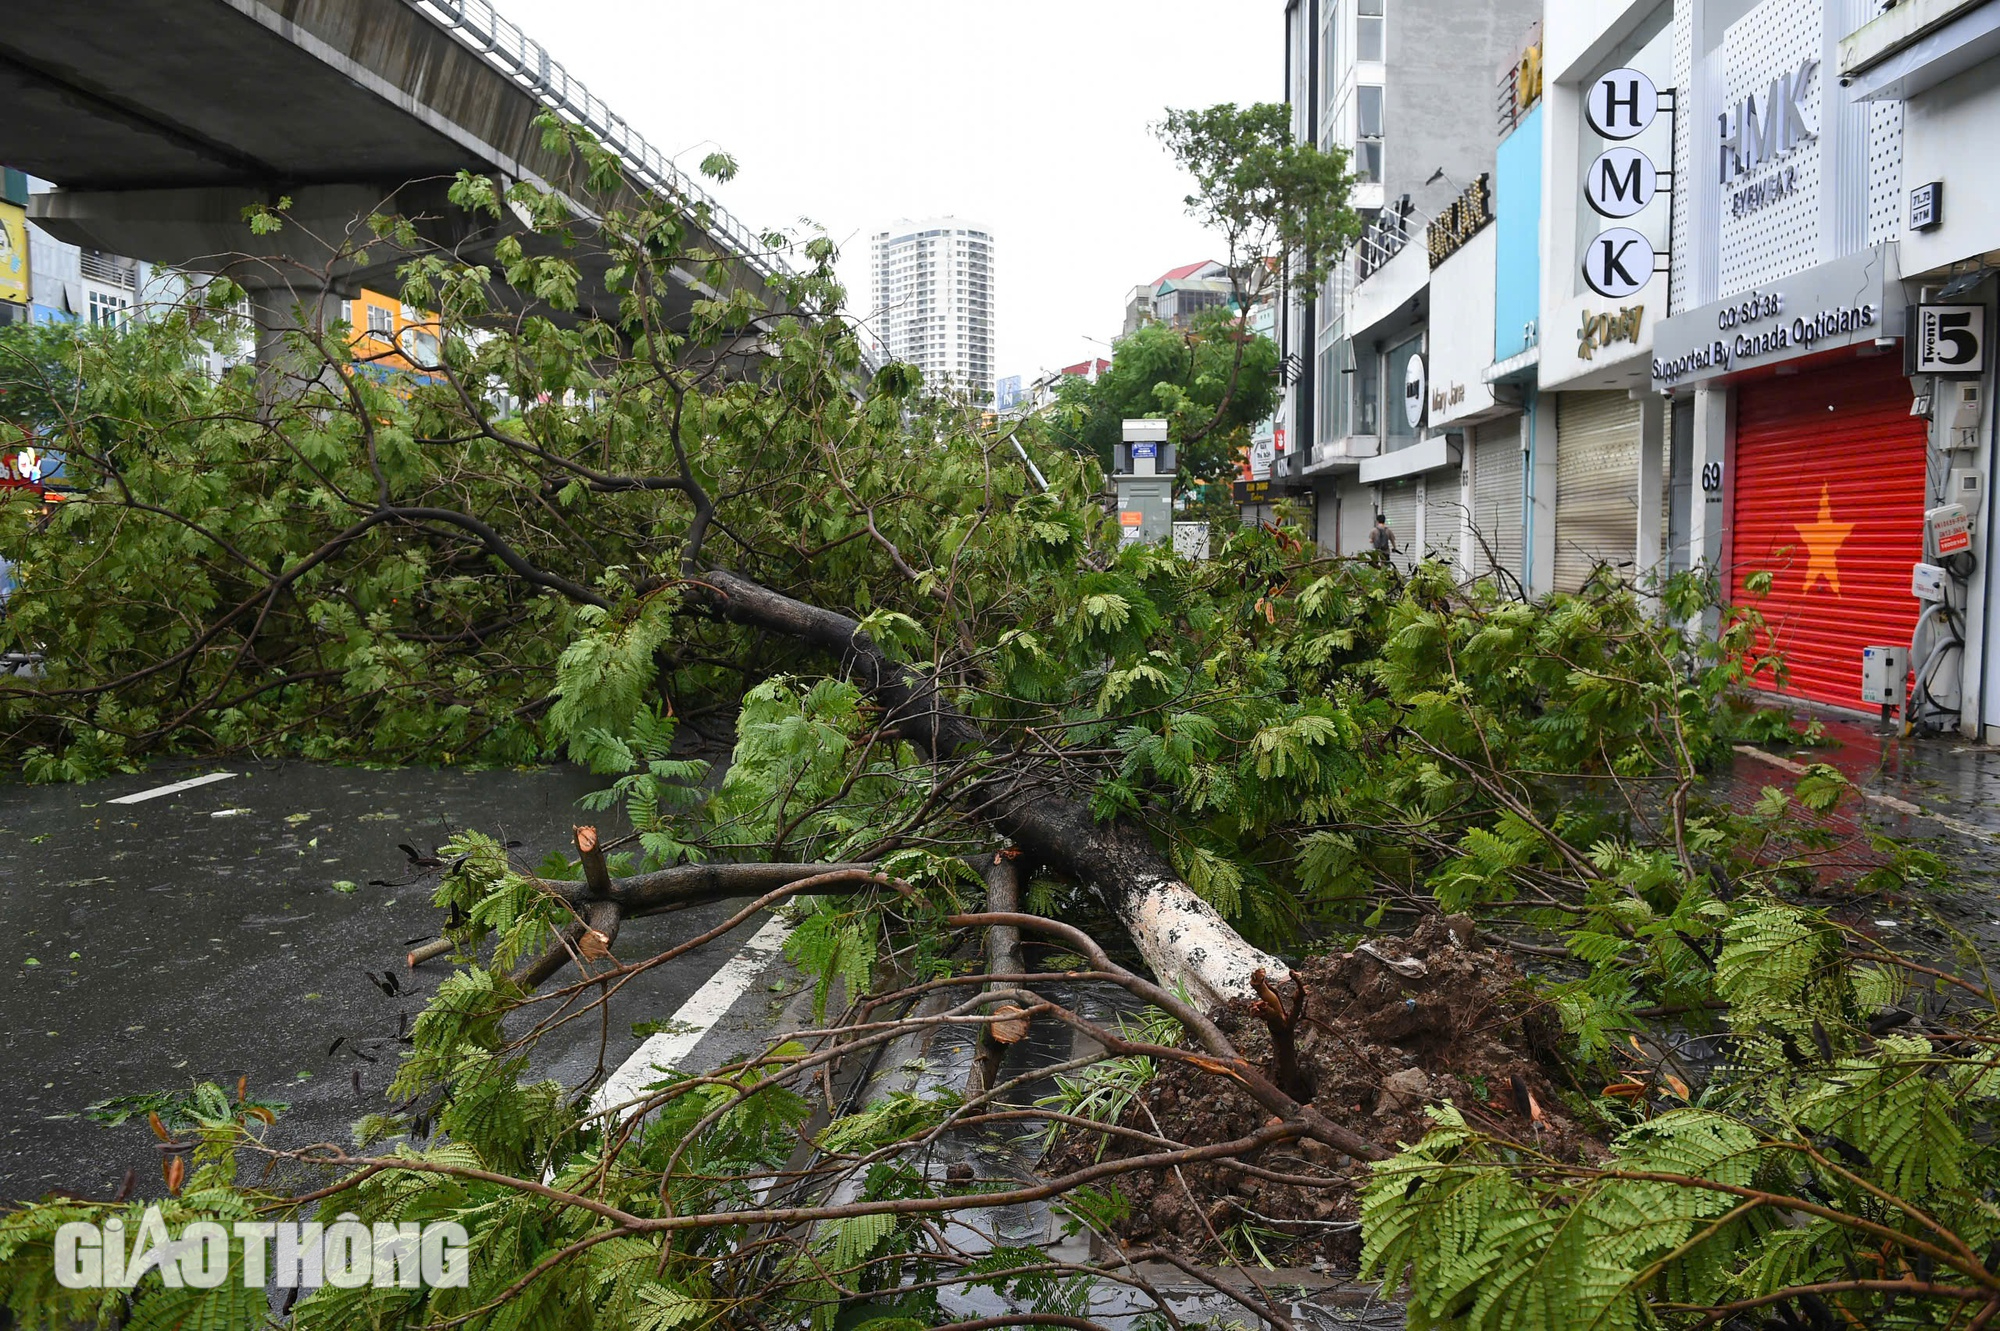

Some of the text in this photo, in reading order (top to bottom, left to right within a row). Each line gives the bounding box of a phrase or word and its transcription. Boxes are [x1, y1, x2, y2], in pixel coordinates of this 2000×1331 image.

[1718, 58, 1818, 184] HMK
[1732, 165, 1796, 217] EYEWEAR
[1913, 212, 1930, 223] HTM
[1763, 293, 1778, 317] 38
[1652, 304, 1872, 384] Supported By Canada Opticians
[1923, 311, 1937, 366] Twenty
[1938, 312, 1979, 365] 5
[1702, 462, 1720, 491] 69
